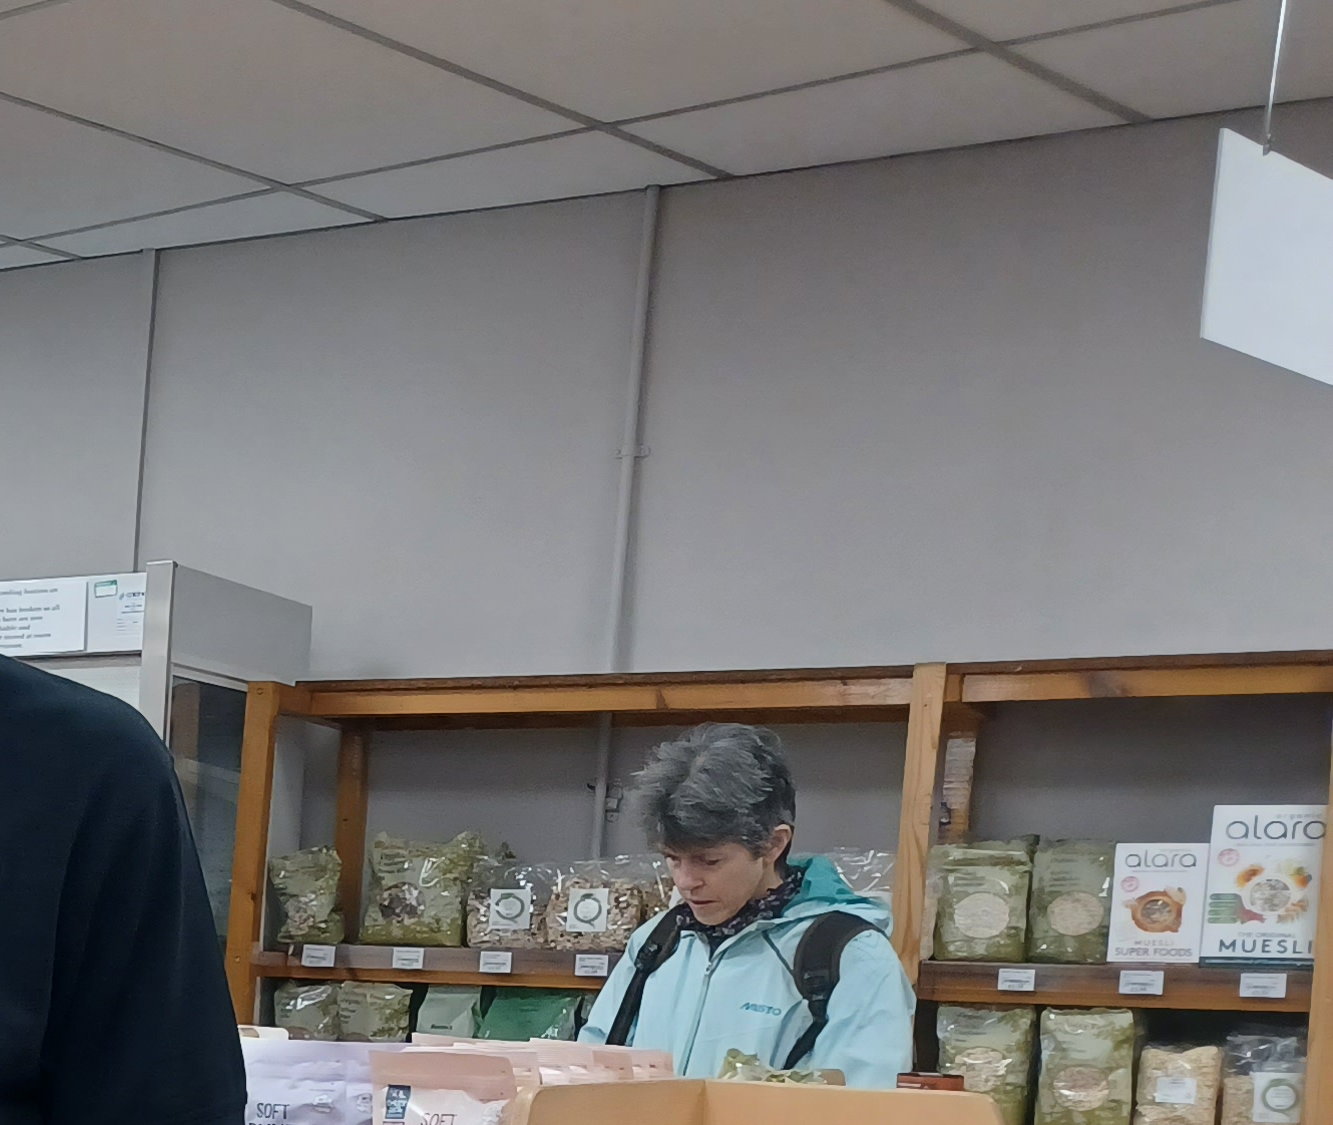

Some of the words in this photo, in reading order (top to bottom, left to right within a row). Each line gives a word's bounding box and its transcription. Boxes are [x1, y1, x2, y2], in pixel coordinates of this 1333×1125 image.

[1225, 814, 1327, 840] alara
[1124, 850, 1198, 868] alara
[1115, 947, 1150, 957] SUPER
[1153, 947, 1193, 958] FOODS
[1218, 938, 1312, 954] MUESLI
[256, 1102, 290, 1120] SOFT
